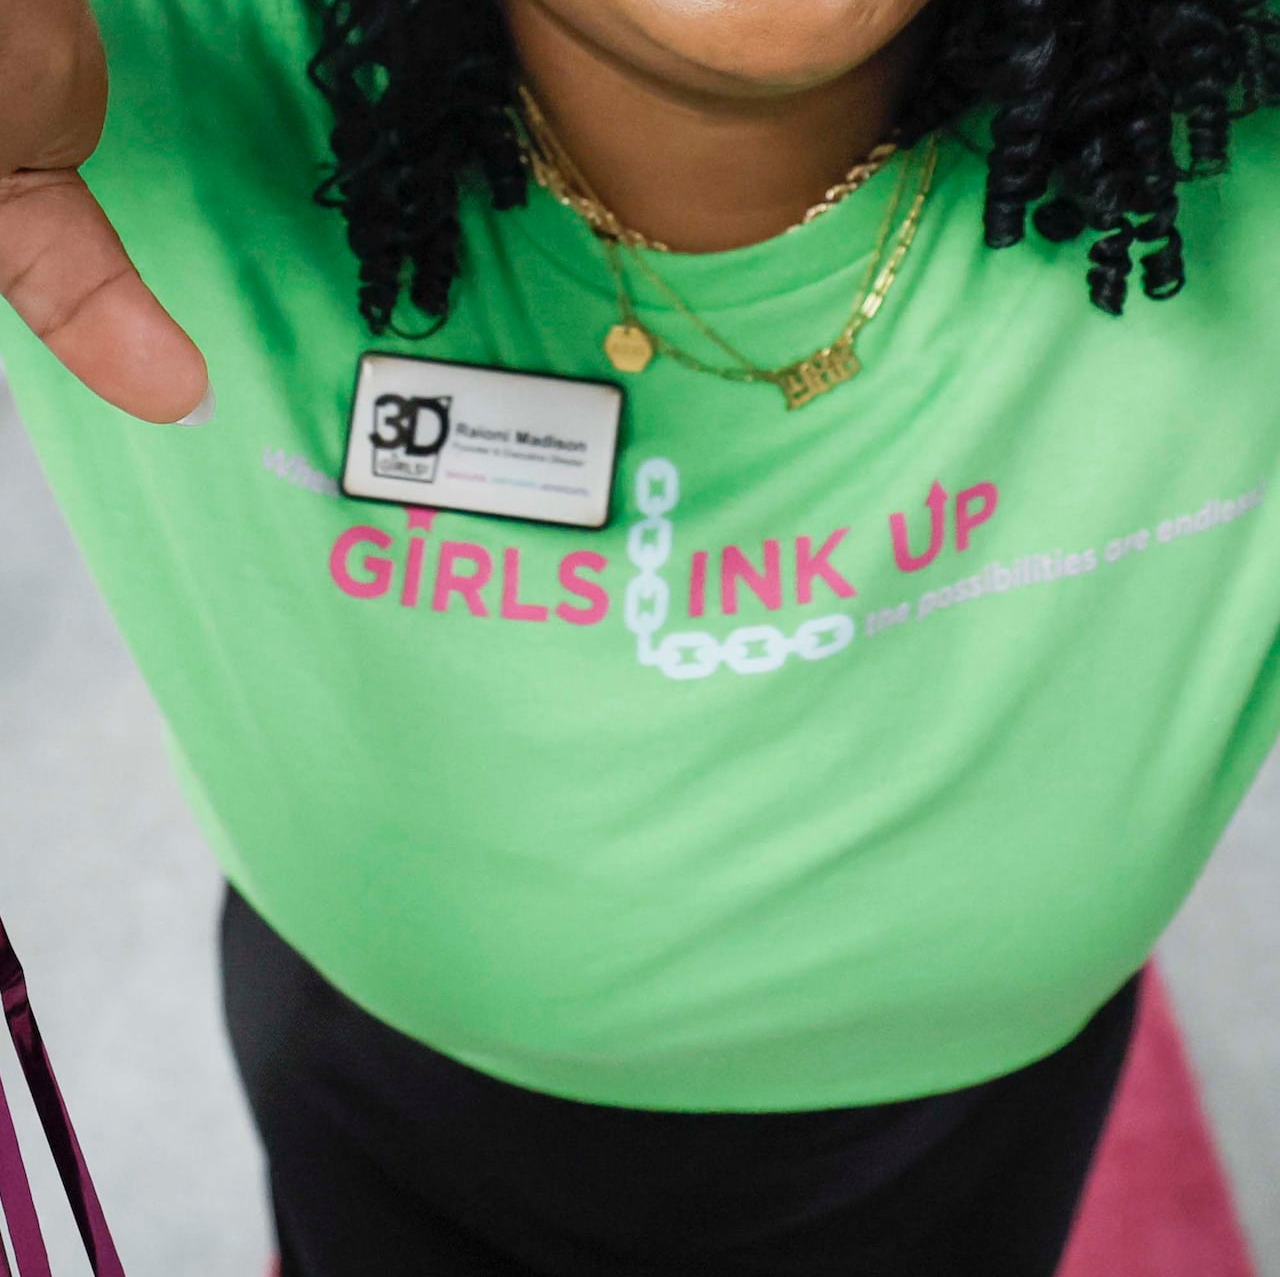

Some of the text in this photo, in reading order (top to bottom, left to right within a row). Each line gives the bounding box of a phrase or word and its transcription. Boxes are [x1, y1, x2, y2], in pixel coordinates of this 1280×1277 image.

[368, 393, 451, 457] 3D
[516, 429, 587, 453] Madison
[328, 507, 610, 626] GIRLS
[888, 480, 999, 573] UP
[917, 548, 1099, 623] possibilities
[1103, 527, 1150, 564] are
